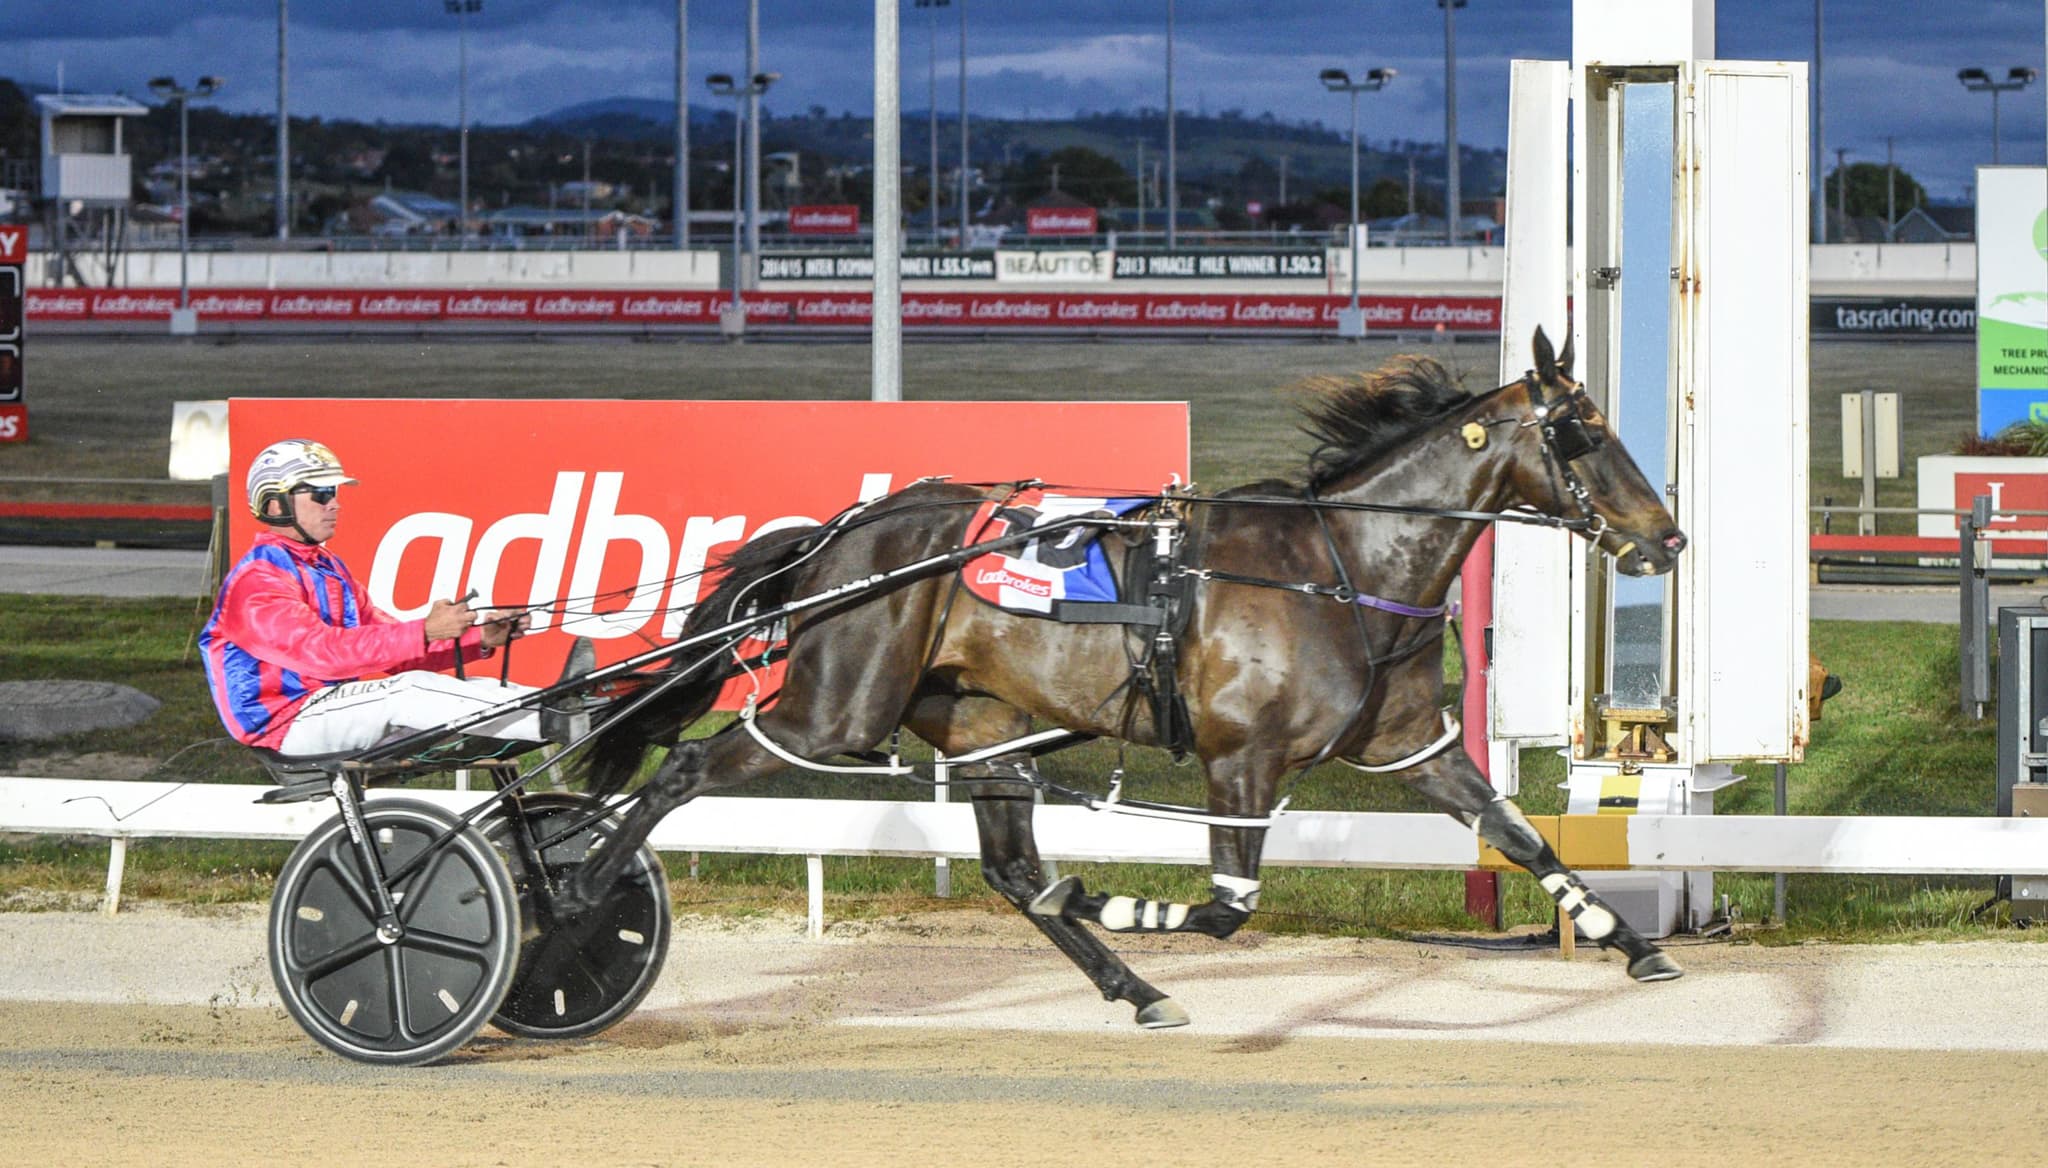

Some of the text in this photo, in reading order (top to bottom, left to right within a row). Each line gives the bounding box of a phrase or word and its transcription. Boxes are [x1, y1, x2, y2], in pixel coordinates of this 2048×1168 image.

[794, 211, 852, 226] Ladbrokes
[1031, 215, 1092, 229] Ladbrokes
[0, 231, 19, 257] Y
[805, 258, 834, 277] INTER
[1116, 256, 1146, 275] 2013
[1149, 256, 1195, 275] MIRACLE
[1199, 256, 1226, 275] MILE
[1228, 256, 1277, 275] WINNER
[92, 295, 175, 314] Ladbrokes
[189, 296, 263, 314] adbrokes
[271, 296, 351, 314] Ladbrokes
[359, 296, 440, 314] Ladbrokes
[447, 296, 528, 315] Ladbrokes
[534, 297, 616, 315] Ladbrokes
[622, 297, 703, 315] Ladbrokes
[970, 300, 1050, 318] Ladbrokes
[1057, 301, 1138, 319] Ladbrokes
[1145, 301, 1227, 320] Ladbrokes
[1233, 302, 1316, 320] Ladbrokes
[1410, 304, 1493, 323] Ladbrokes
[2000, 348, 2028, 358] TREE
[976, 569, 1051, 597] Ladbrokes
